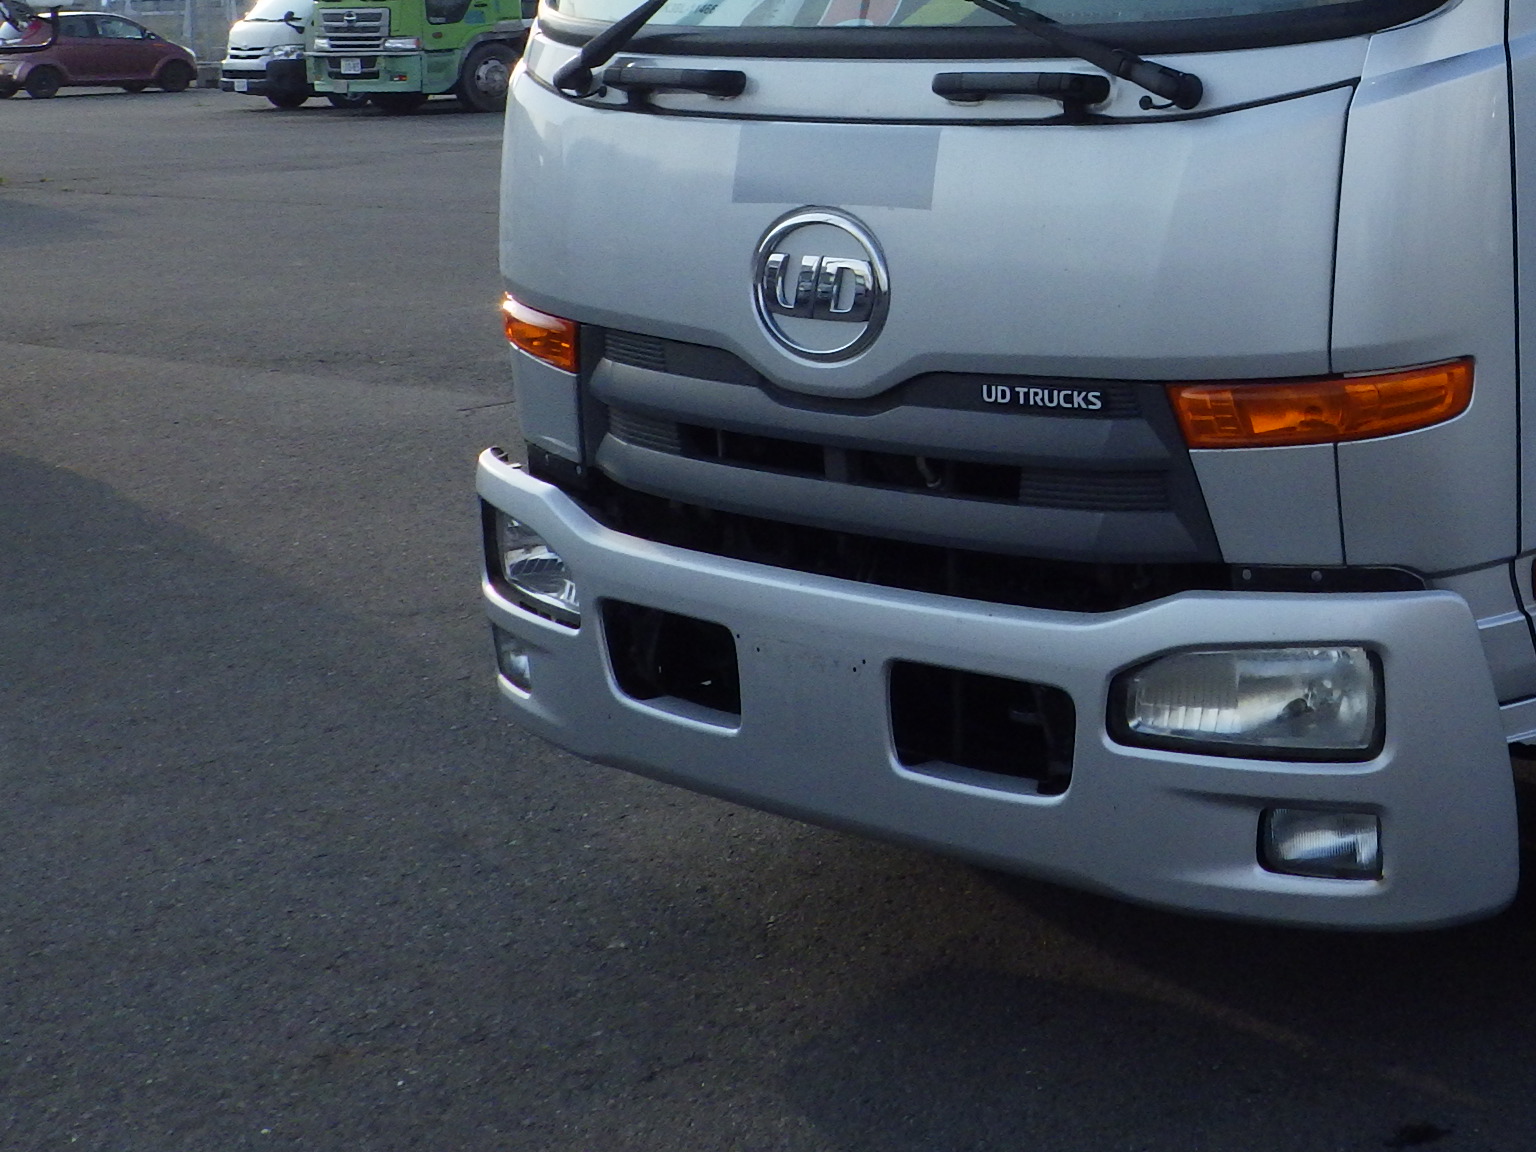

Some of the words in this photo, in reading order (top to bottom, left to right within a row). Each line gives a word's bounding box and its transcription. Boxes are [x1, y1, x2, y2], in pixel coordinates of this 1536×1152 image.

[765, 252, 874, 322] UD
[982, 384, 1011, 403] UD
[1015, 387, 1102, 410] TRUCKS
